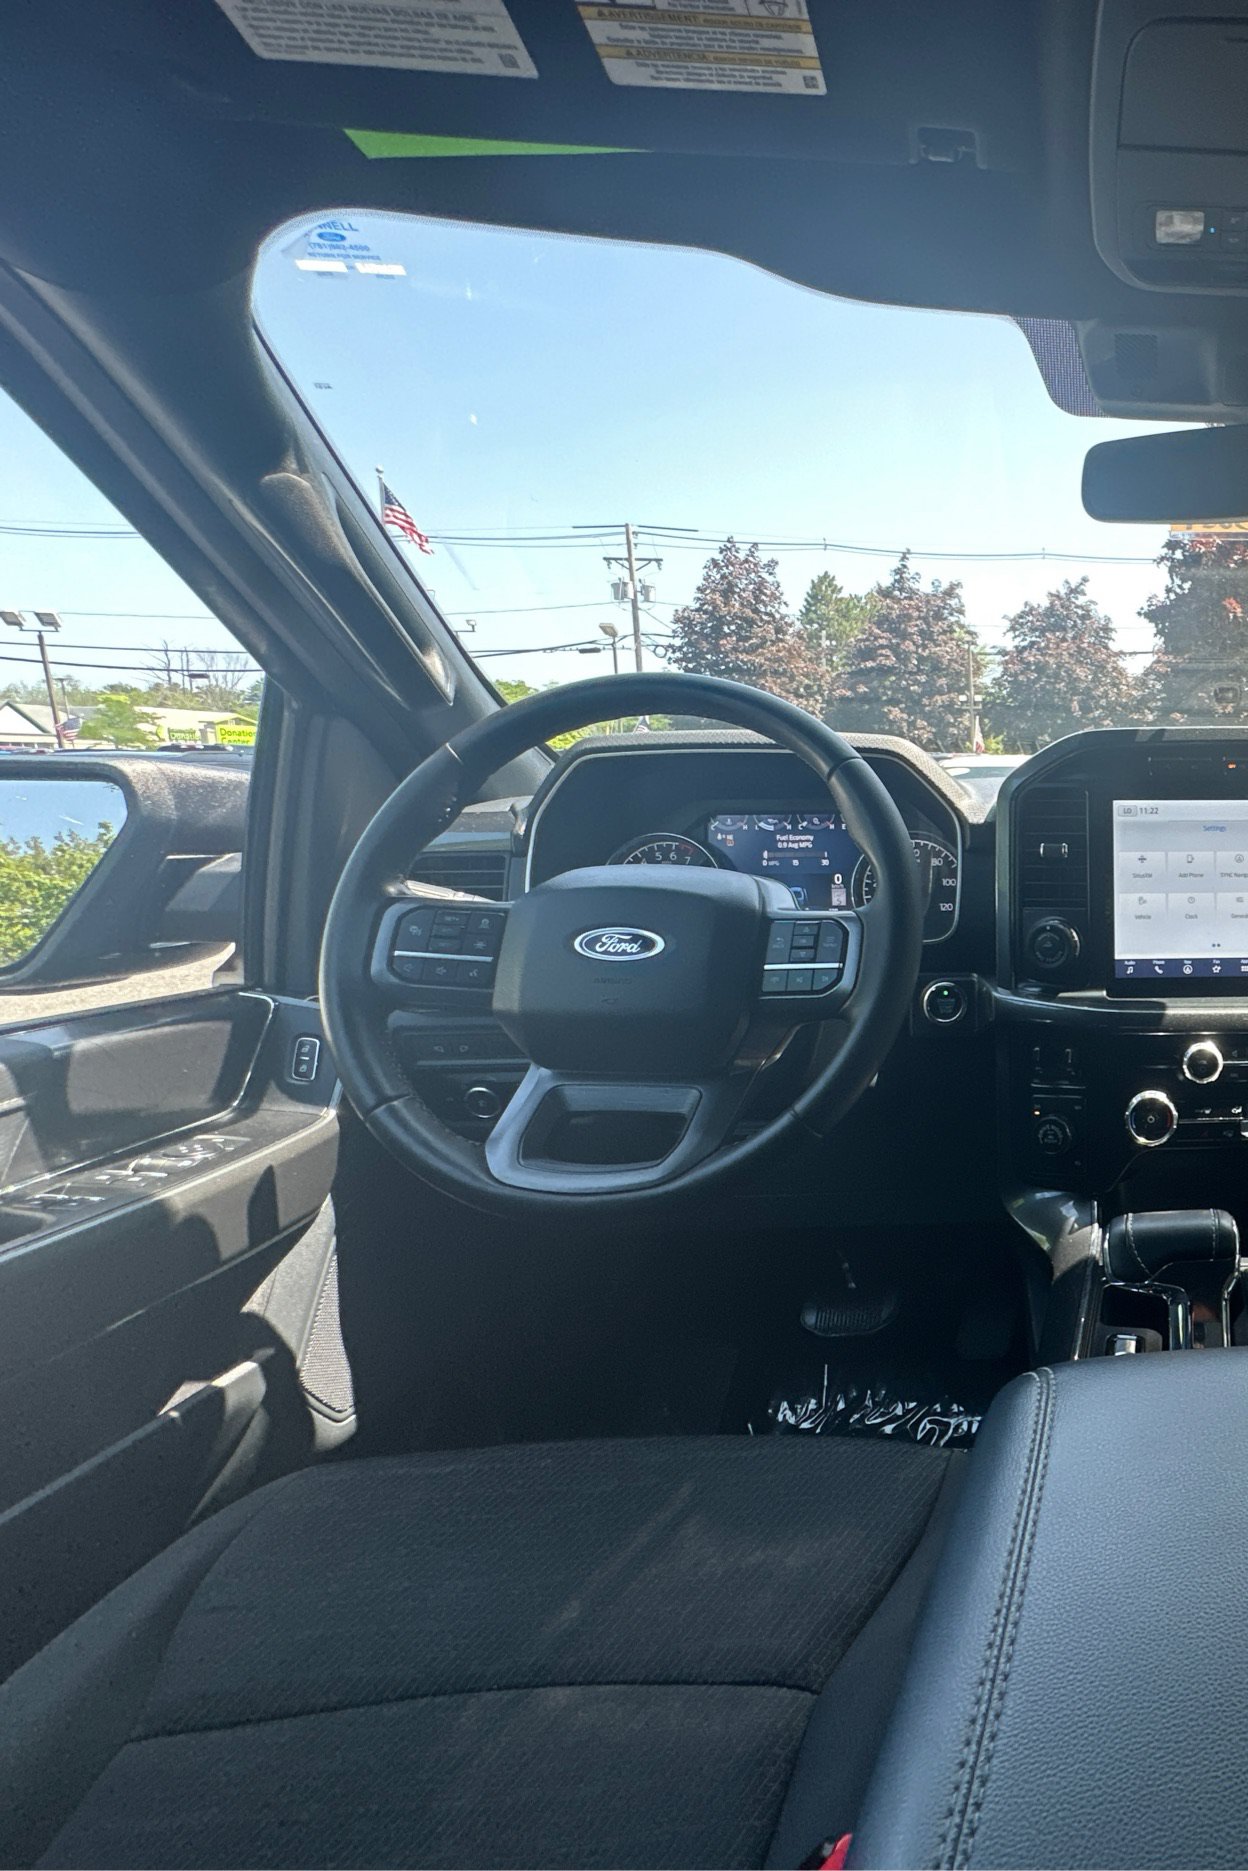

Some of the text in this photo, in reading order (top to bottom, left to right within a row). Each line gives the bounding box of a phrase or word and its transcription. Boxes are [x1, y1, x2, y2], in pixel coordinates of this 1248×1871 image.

[789, 834, 814, 842] Economy
[656, 852, 662, 861] 5
[670, 852, 677, 860] 6
[684, 856, 691, 864] 7
[834, 873, 843, 884] 0
[942, 878, 957, 886] 100
[940, 903, 953, 911] 120
[595, 933, 642, 953] Ford
